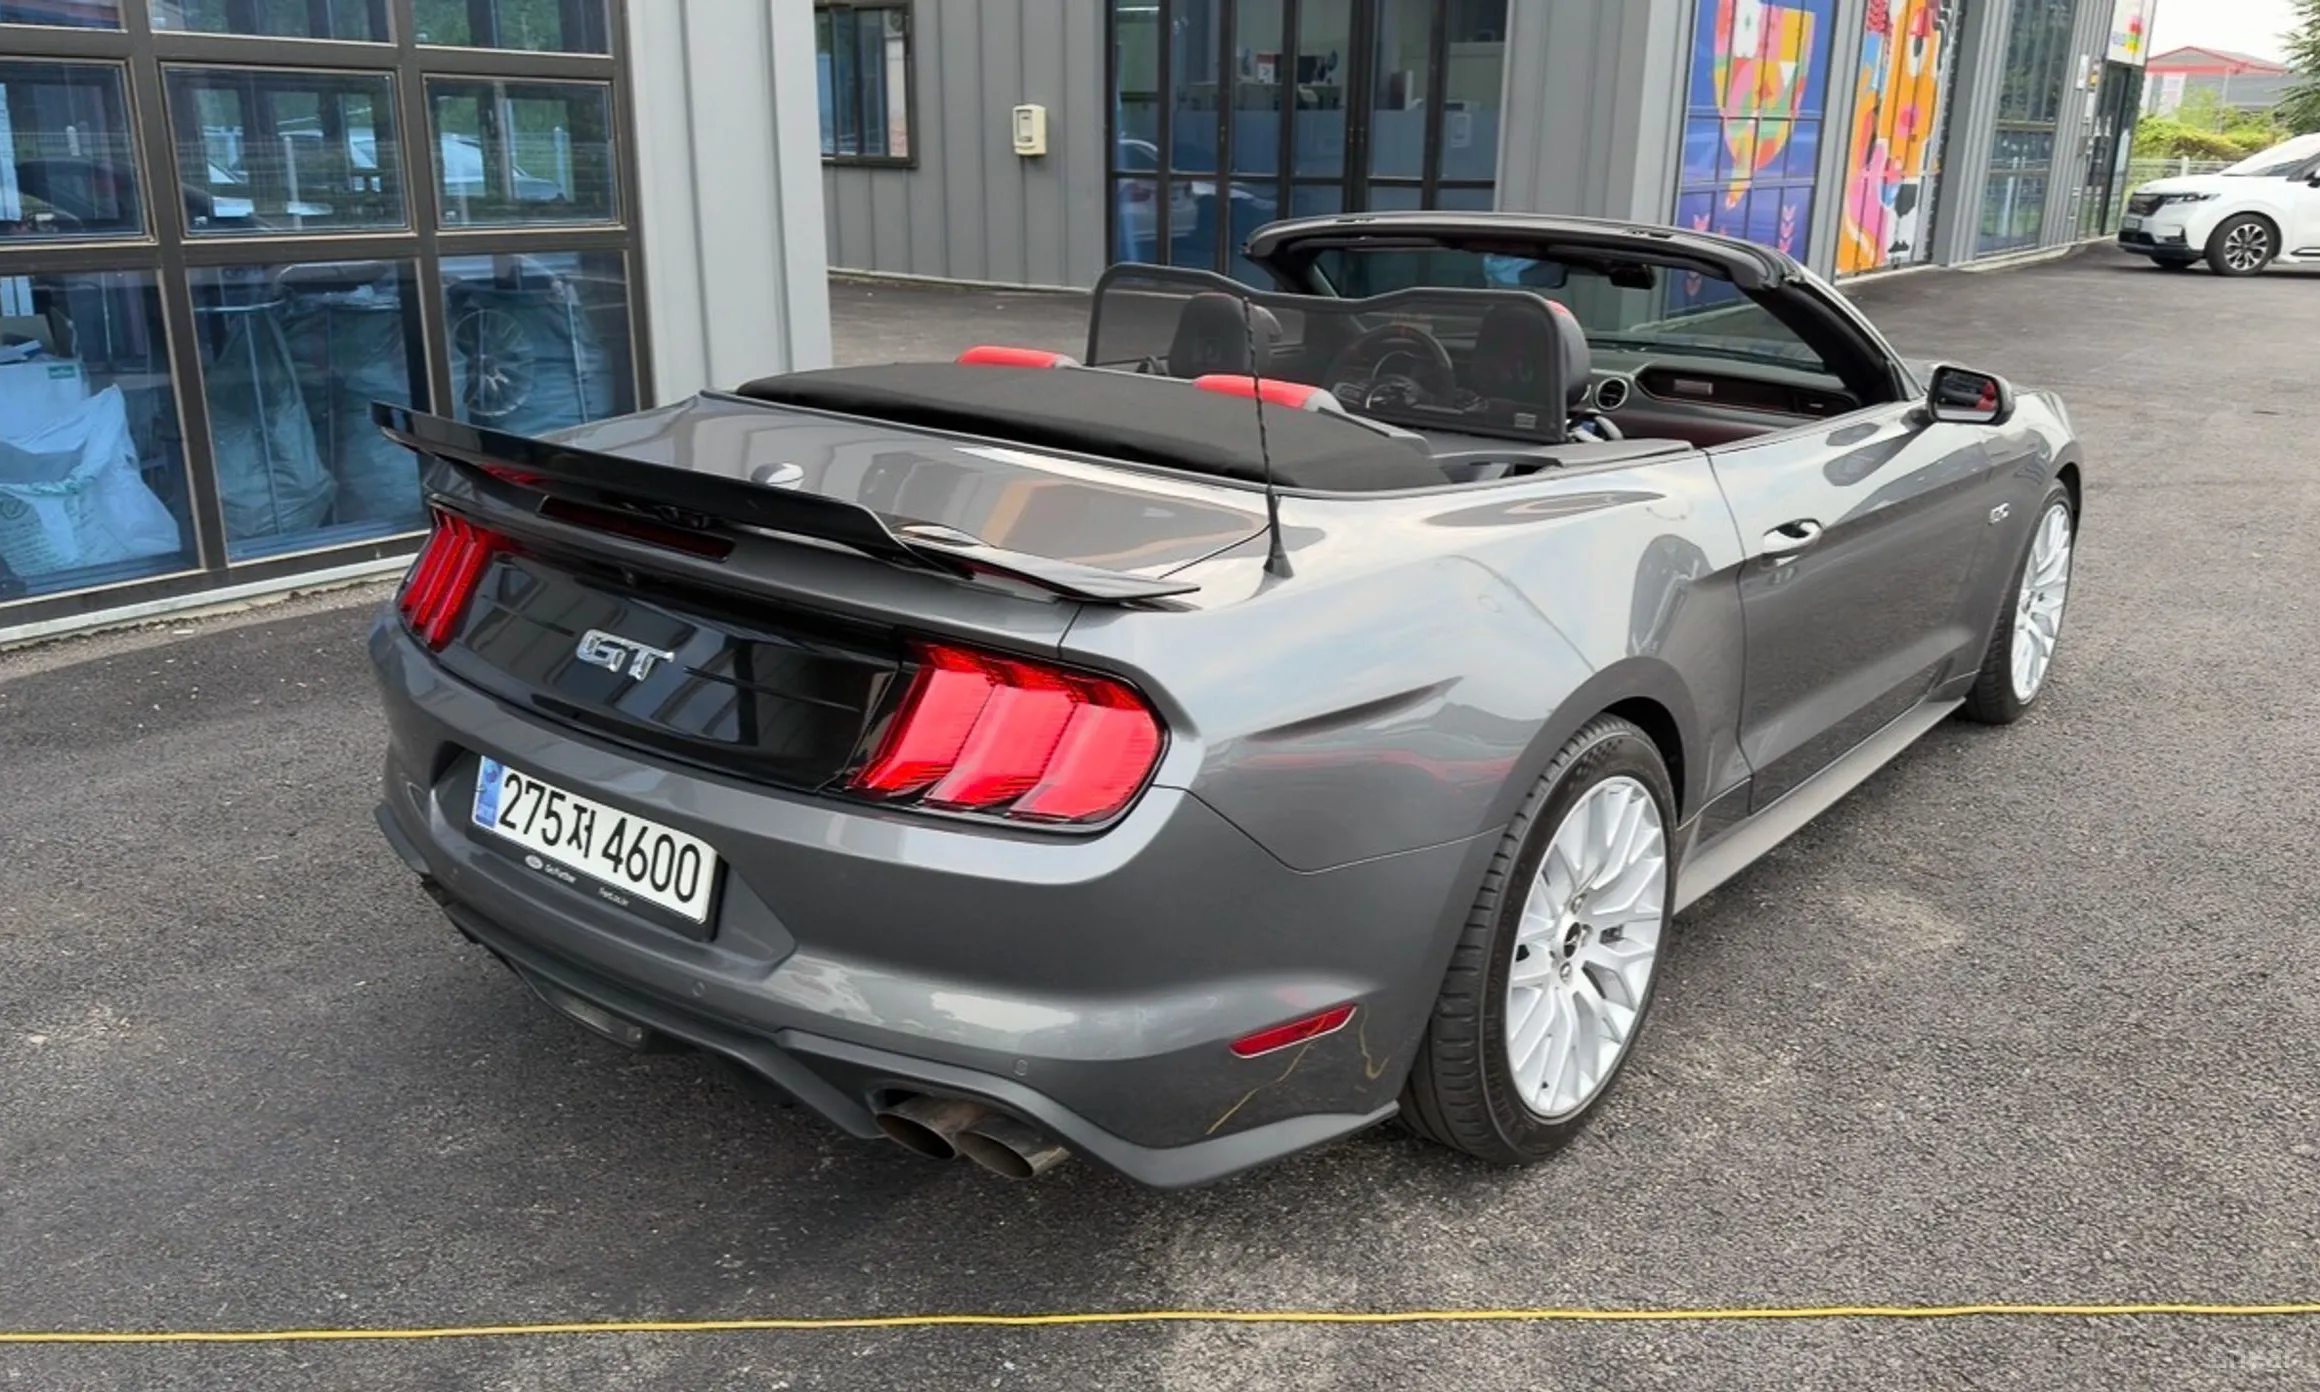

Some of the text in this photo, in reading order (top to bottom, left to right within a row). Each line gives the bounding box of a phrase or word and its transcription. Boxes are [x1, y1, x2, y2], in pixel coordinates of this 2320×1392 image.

[576, 629, 675, 681] GT
[499, 773, 701, 903] 275저 4600
